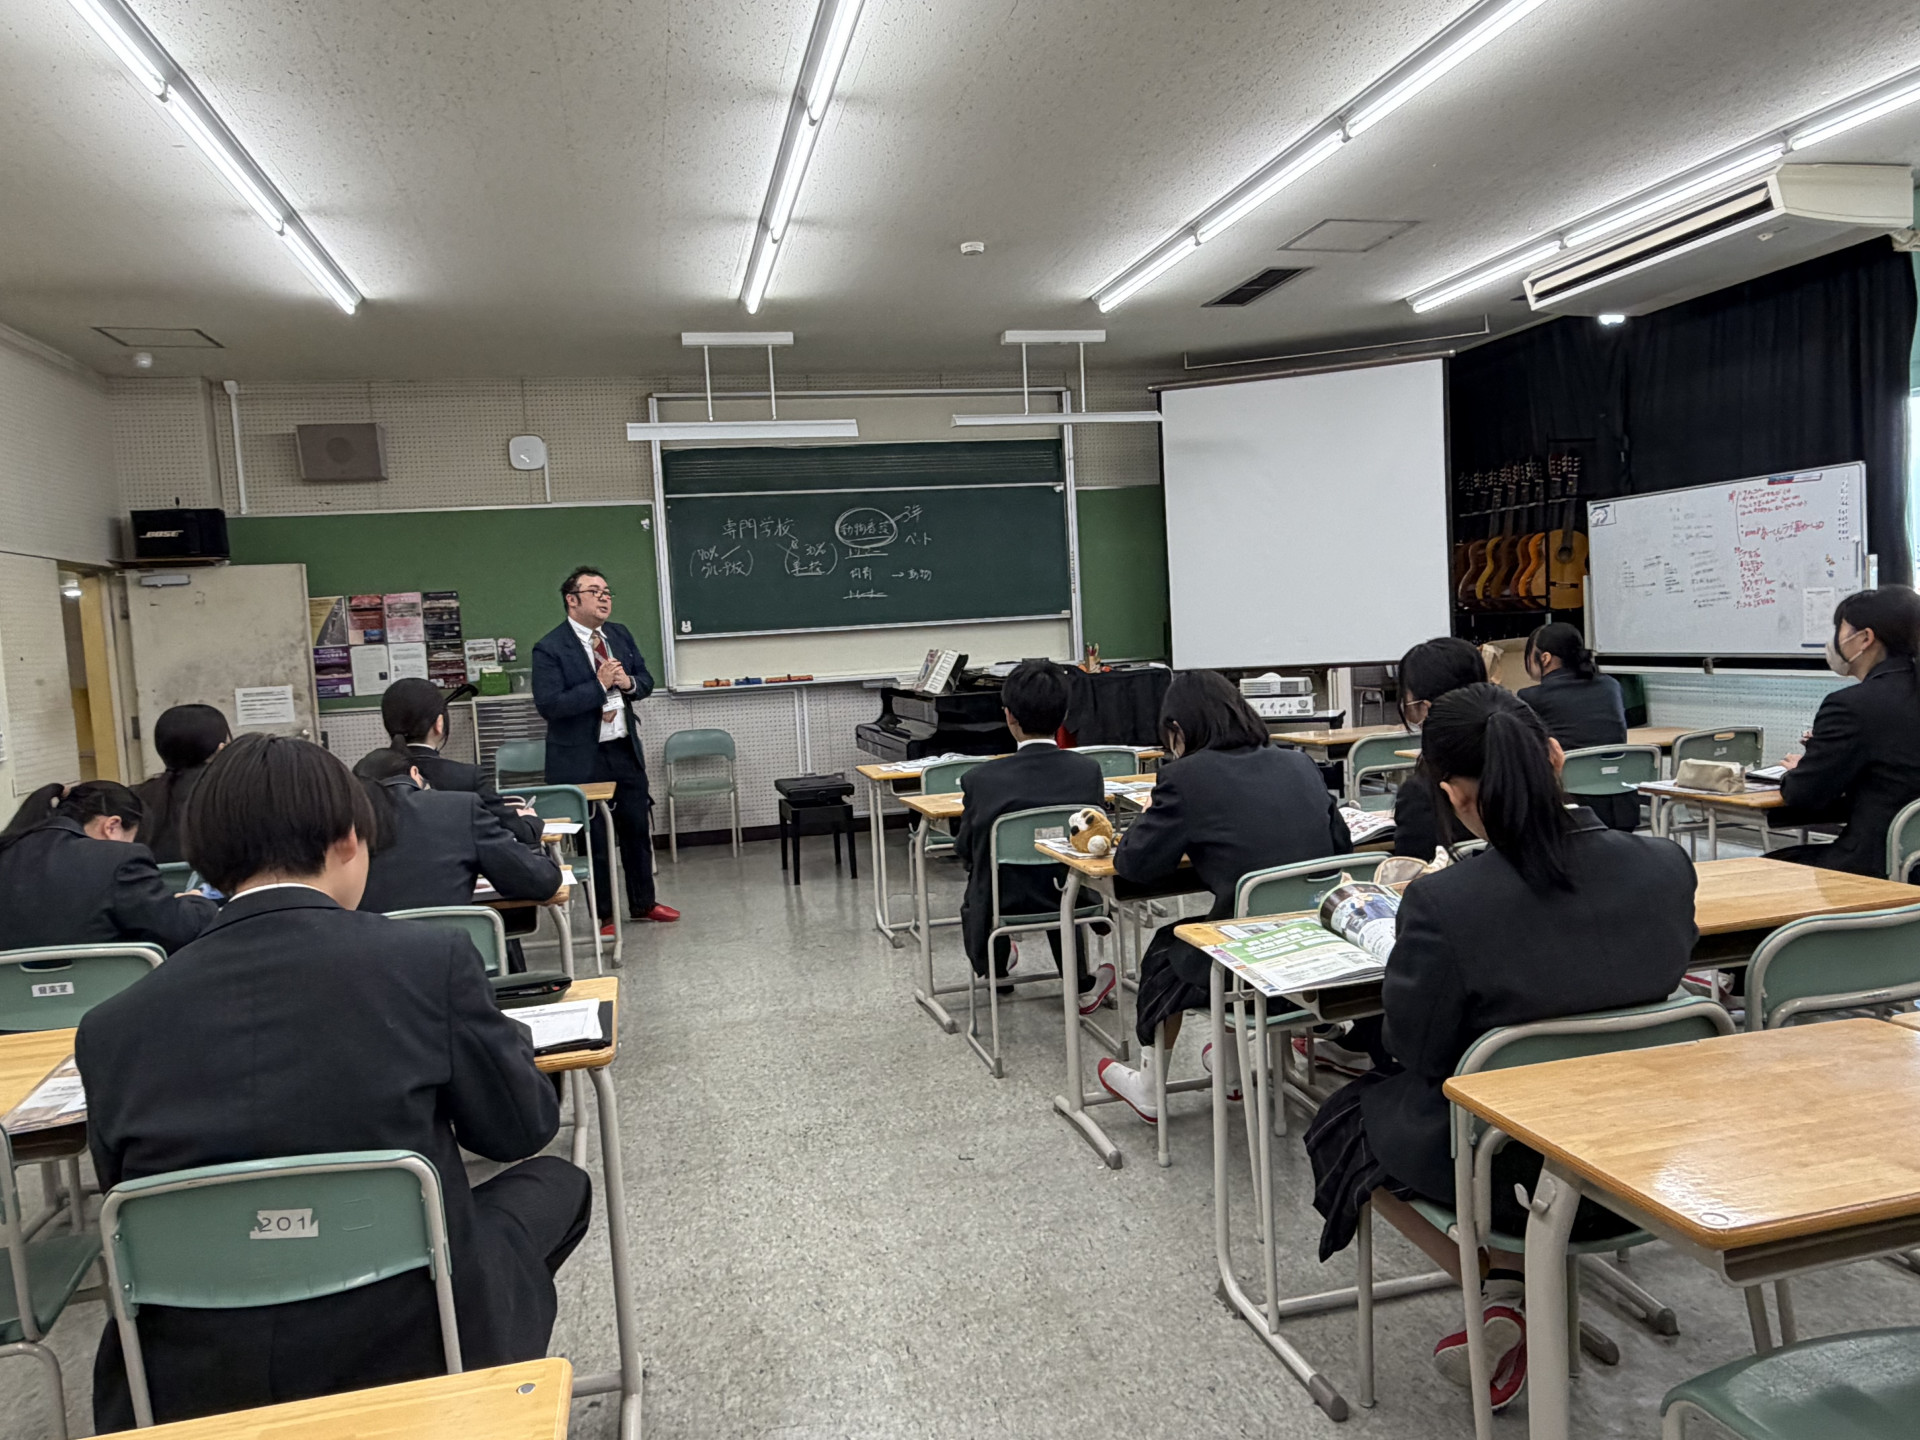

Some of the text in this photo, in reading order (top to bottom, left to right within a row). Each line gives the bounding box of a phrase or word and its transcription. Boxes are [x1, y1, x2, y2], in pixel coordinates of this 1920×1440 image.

[141, 530, 183, 538] BOSE
[722, 516, 798, 540] 専門学校
[259, 1215, 306, 1233] 201
